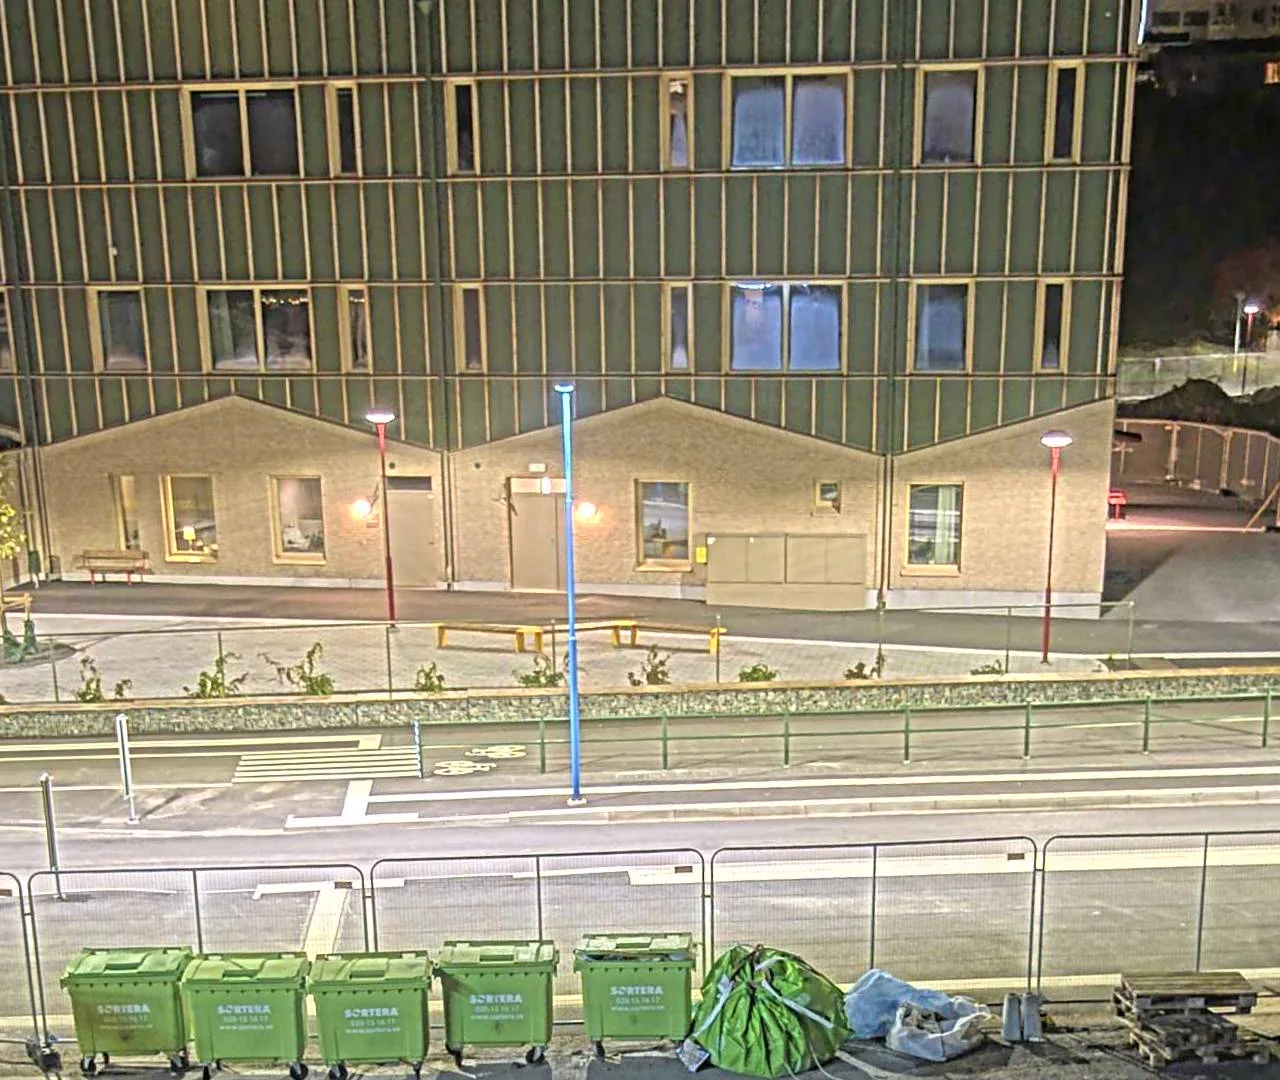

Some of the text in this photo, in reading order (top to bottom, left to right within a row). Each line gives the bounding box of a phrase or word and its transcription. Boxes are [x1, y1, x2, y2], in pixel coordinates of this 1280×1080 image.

[609, 986, 663, 996] SORTERA
[469, 994, 523, 1004] SORTERA
[217, 1004, 271, 1014] SORTERA
[344, 1007, 399, 1018] SORTERA
